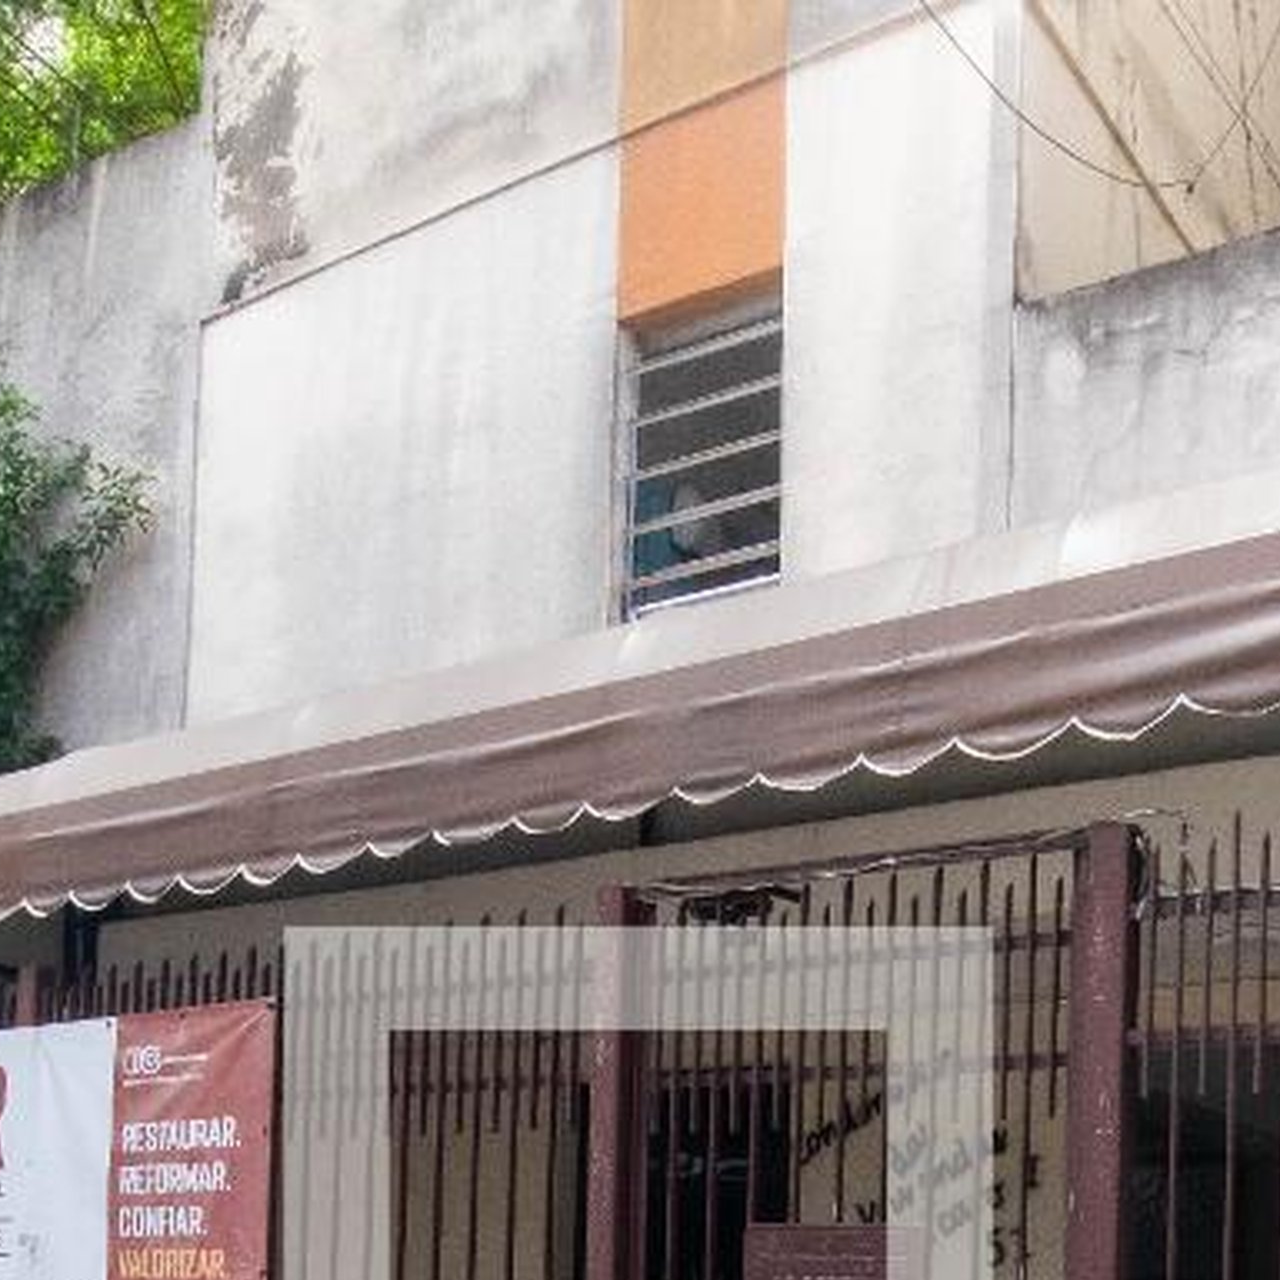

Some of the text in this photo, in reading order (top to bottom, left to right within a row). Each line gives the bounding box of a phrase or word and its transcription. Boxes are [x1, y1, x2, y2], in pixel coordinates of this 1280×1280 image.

[121, 1115, 242, 1153] RESTAURAR.
[119, 1160, 232, 1194] REFORMAR.
[119, 1205, 209, 1238] CONFIAR.
